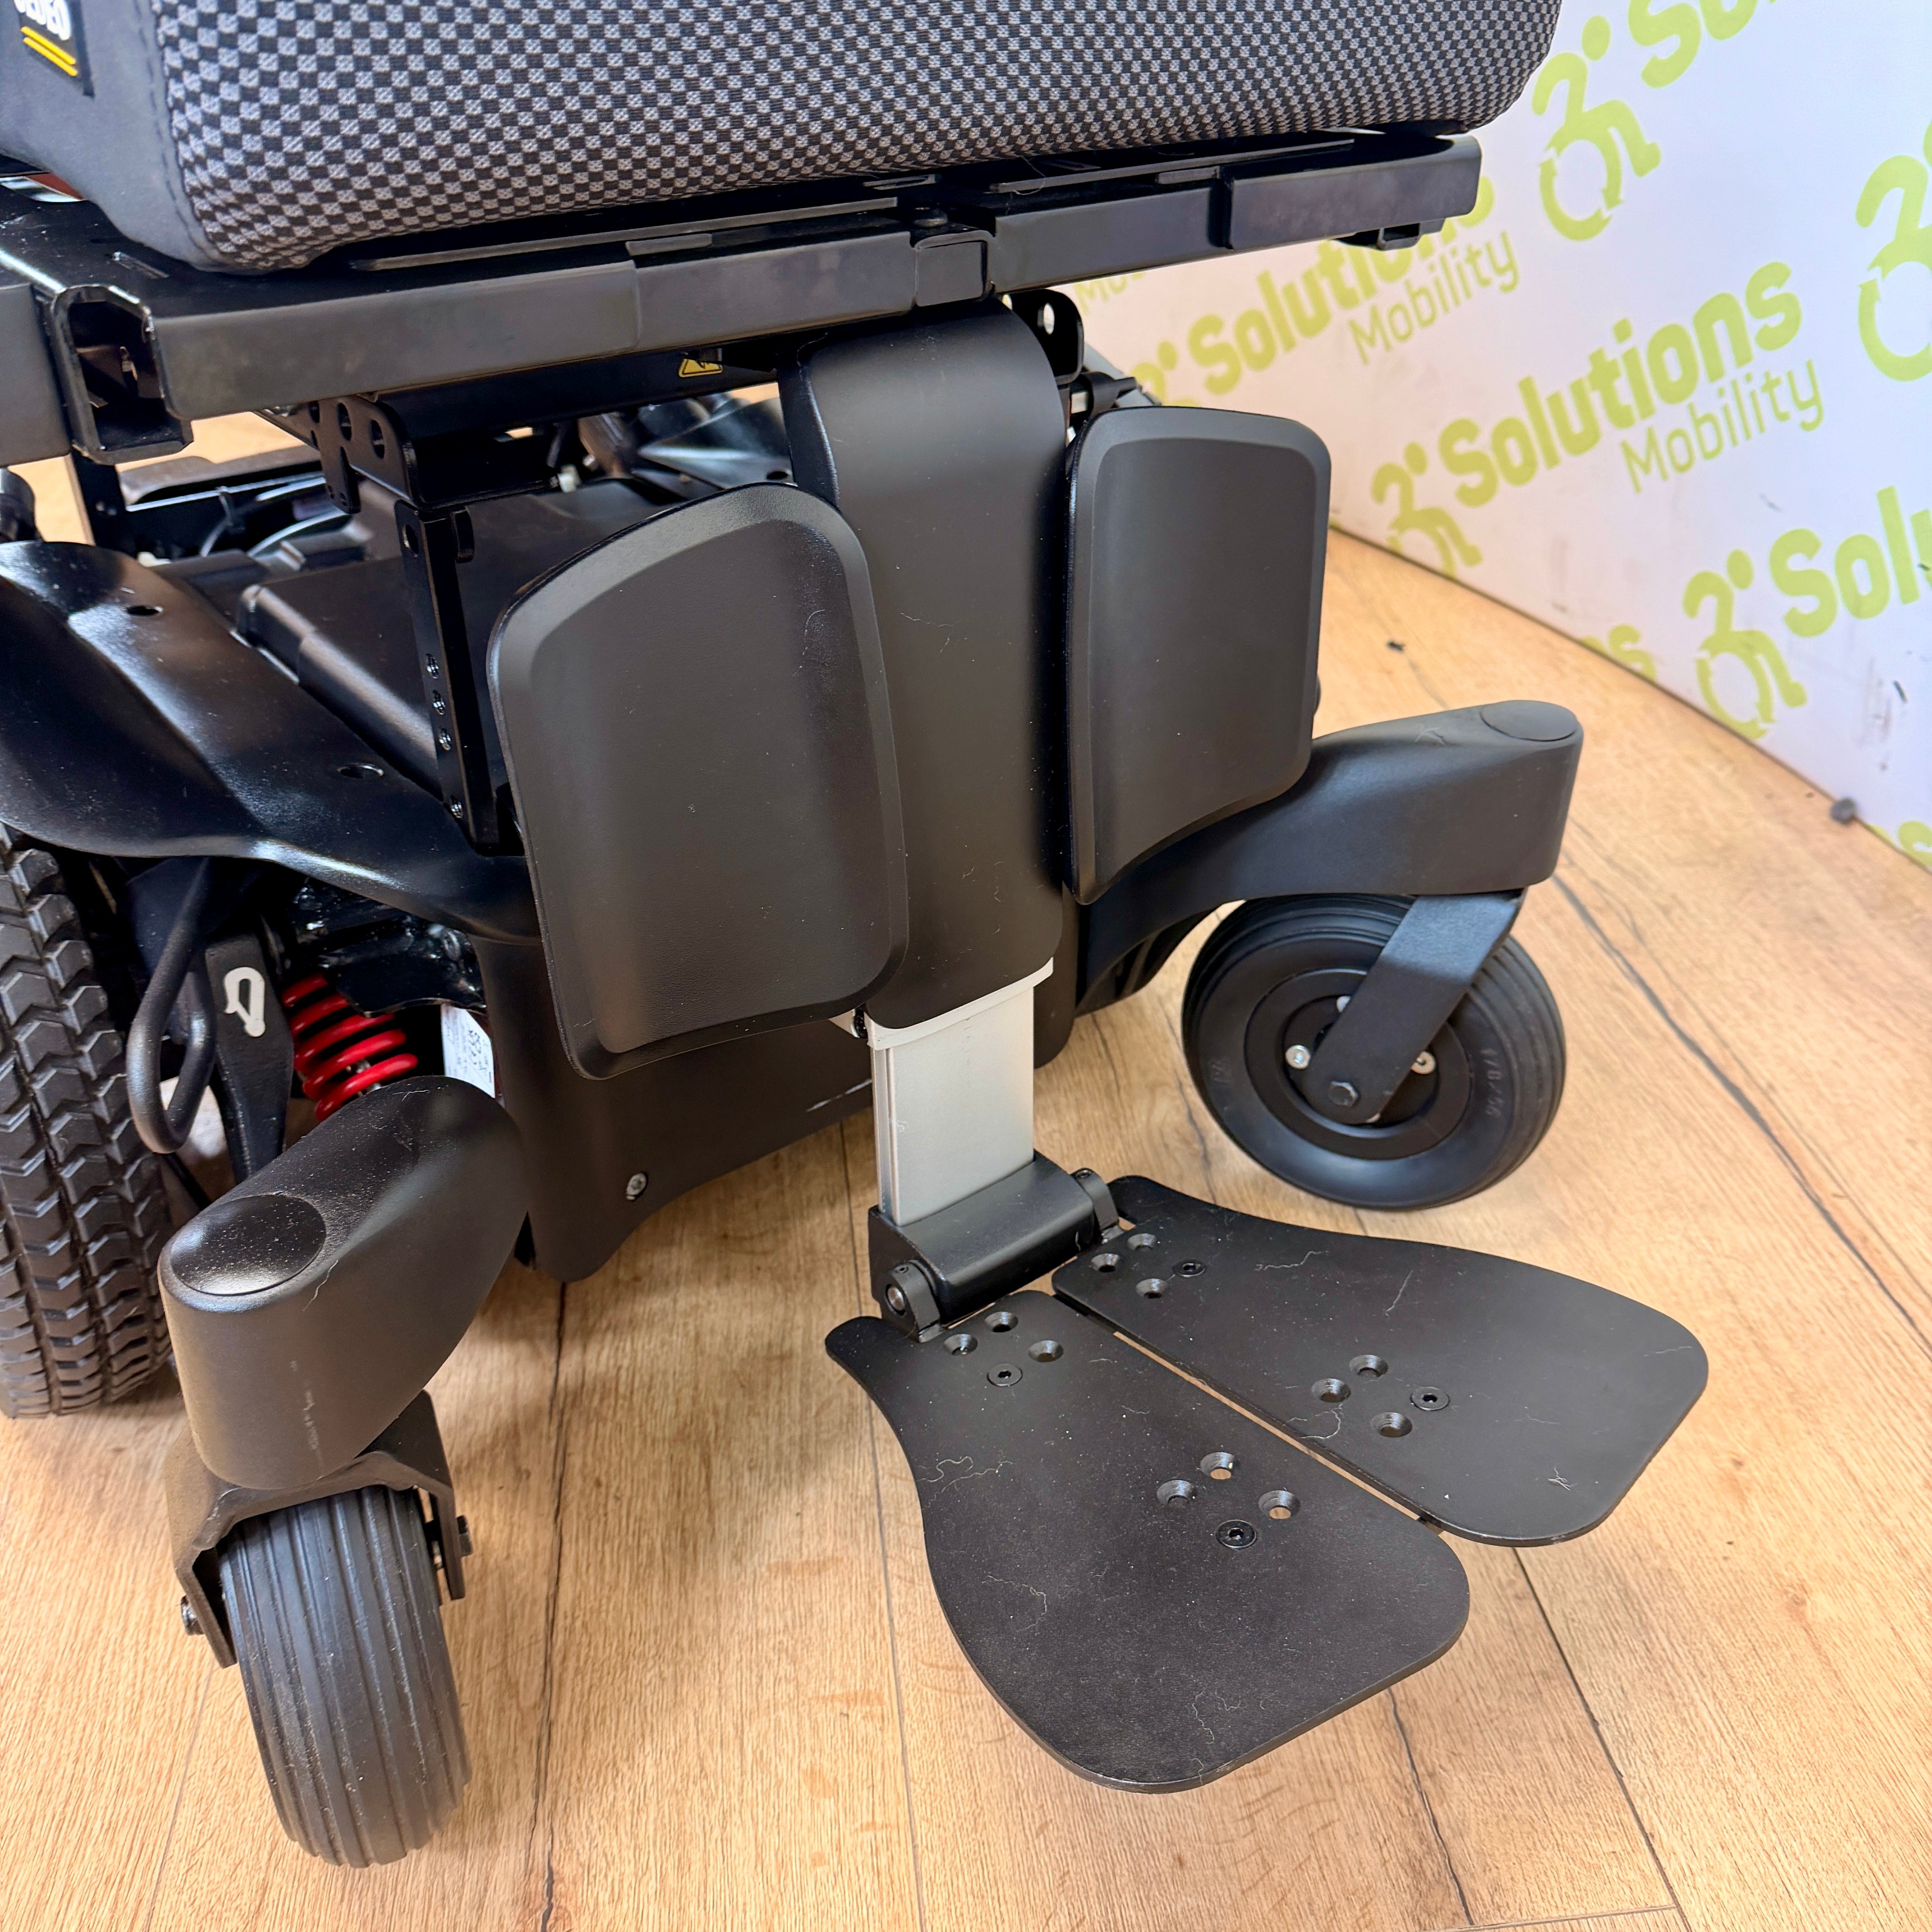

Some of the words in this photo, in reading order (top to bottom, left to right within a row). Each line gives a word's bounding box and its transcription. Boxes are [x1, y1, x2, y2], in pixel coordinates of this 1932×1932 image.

[1348, 231, 1520, 365] Mobility
[1439, 261, 1802, 508] Solutions
[1620, 359, 1823, 494] Mobility
